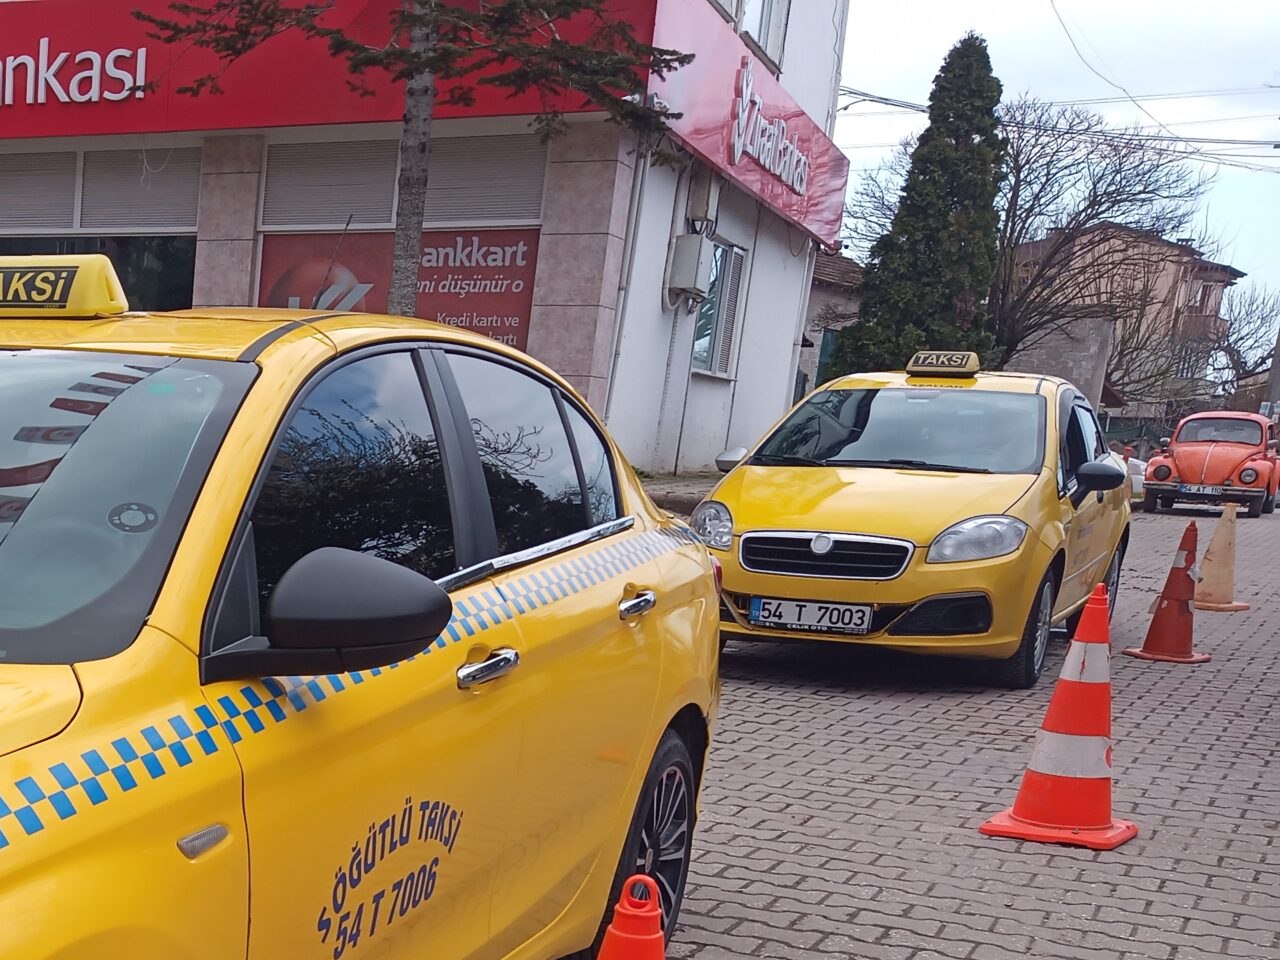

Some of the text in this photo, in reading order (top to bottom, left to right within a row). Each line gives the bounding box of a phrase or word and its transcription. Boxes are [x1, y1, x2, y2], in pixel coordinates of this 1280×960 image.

[419, 236, 528, 267] ankkart
[438, 275, 510, 298] düşünür
[512, 280, 524, 293] o
[436, 313, 519, 327] Kredi kartı ve
[761, 602, 783, 620] 54
[795, 604, 807, 622] T
[816, 605, 866, 627] 7003
[317, 796, 414, 944] SÖĞÜTLÜ
[333, 856, 440, 960] 54 T 7006
